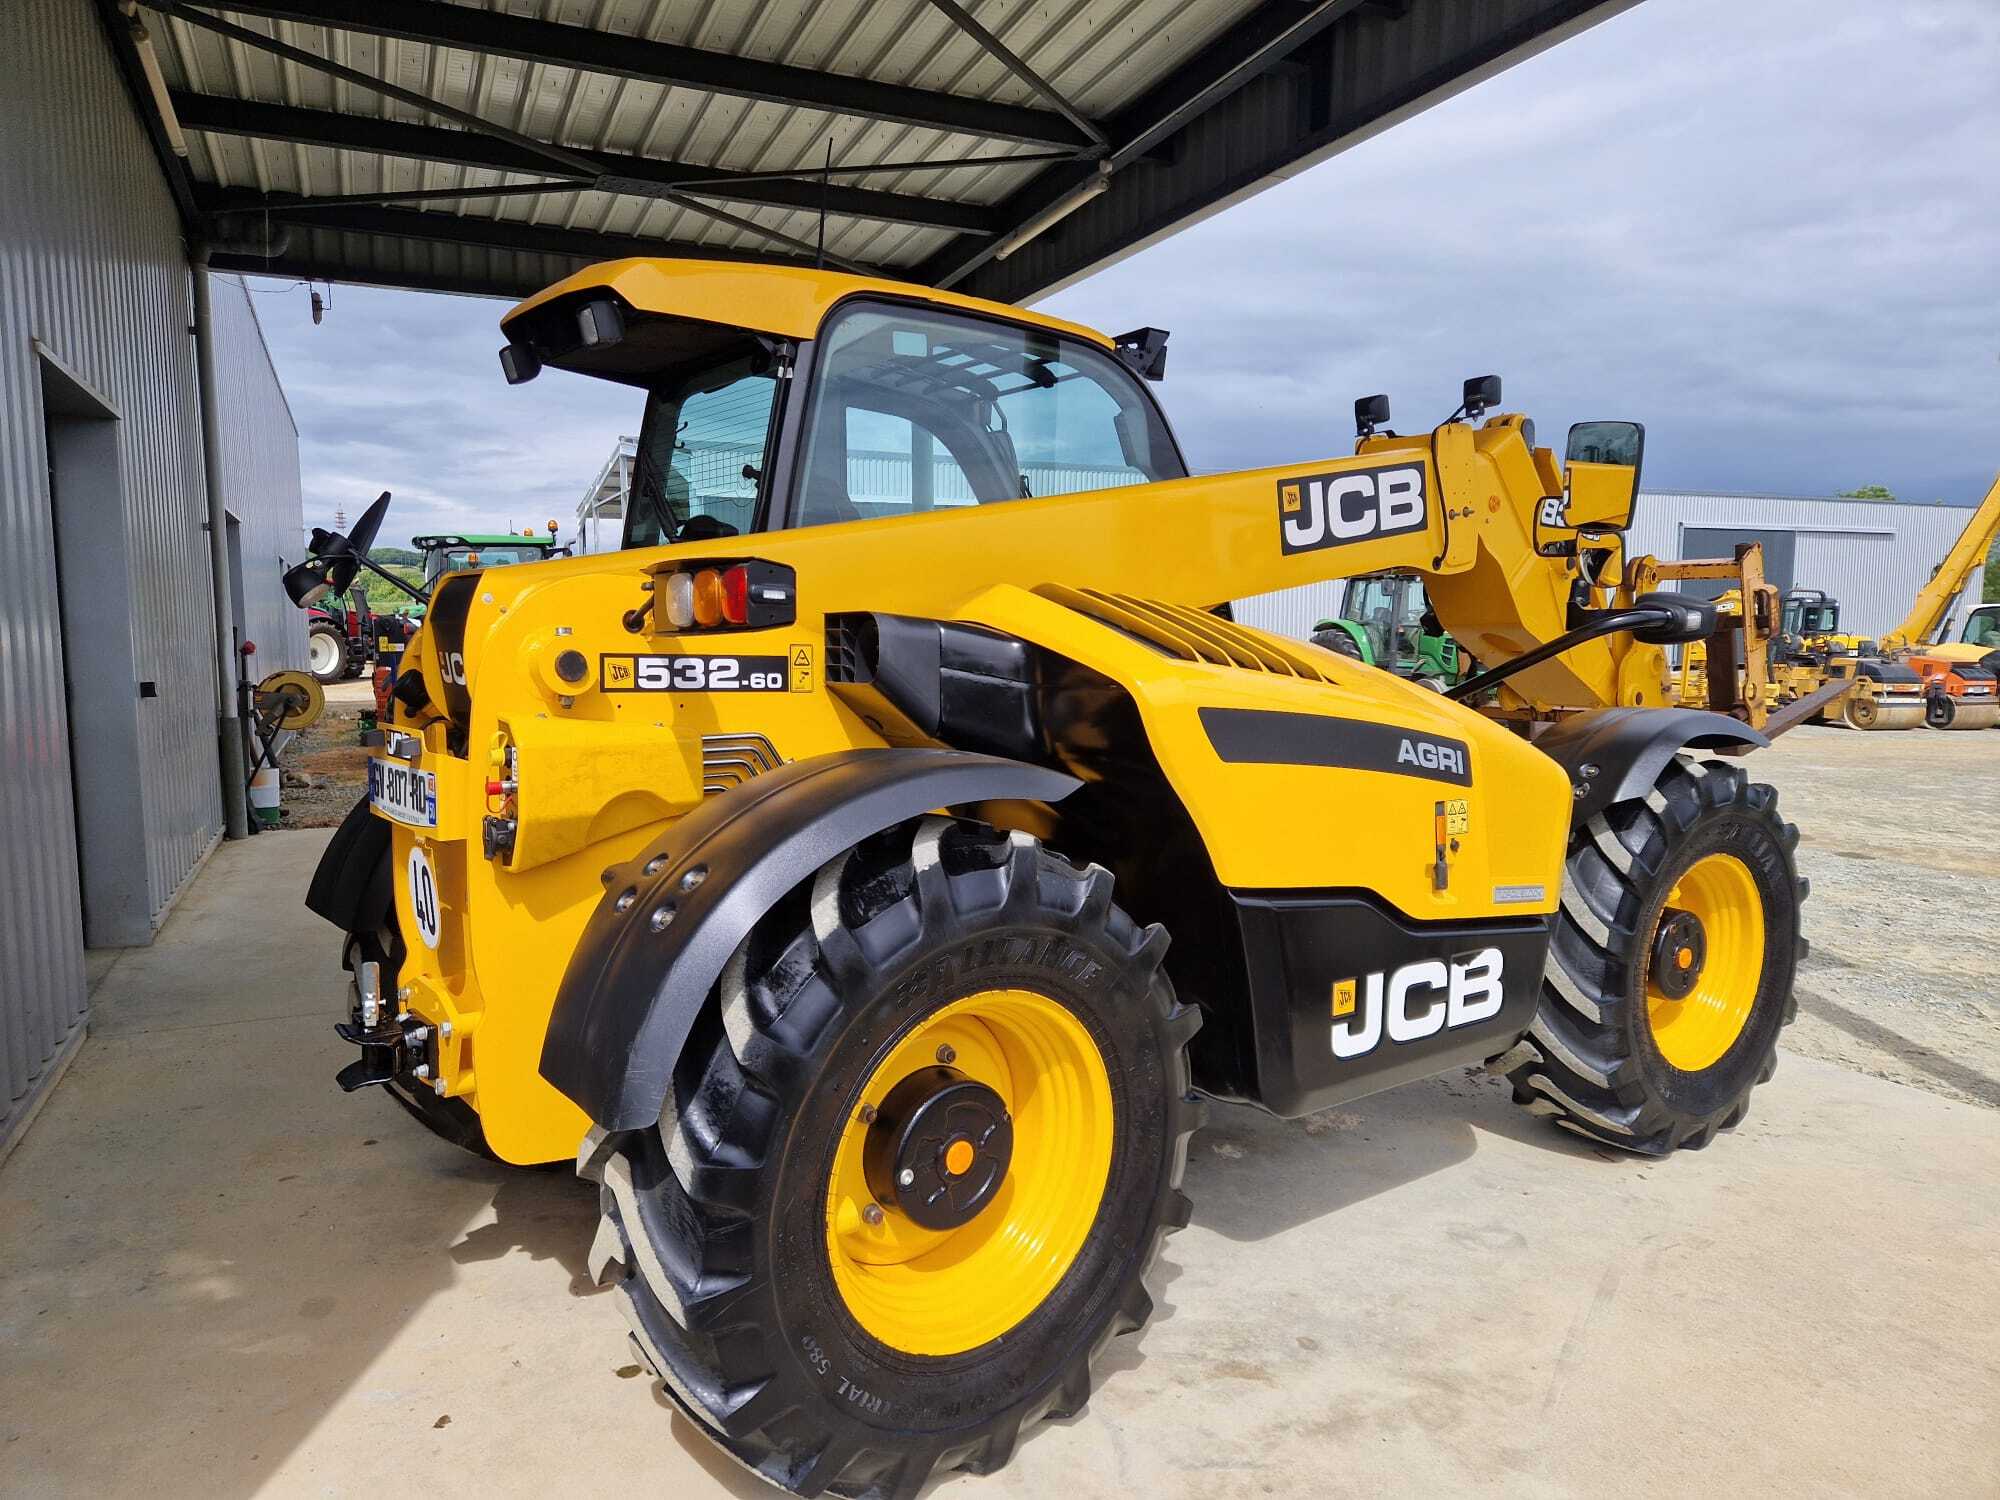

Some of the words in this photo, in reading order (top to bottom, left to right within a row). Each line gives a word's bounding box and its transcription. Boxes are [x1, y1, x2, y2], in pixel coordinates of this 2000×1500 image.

[1285, 468, 1424, 547] JCB
[439, 652, 466, 686] JC
[612, 664, 629, 681] JCB
[1398, 739, 1465, 775] AGRI
[413, 860, 435, 936] 40
[1331, 947, 1503, 1058] JCB
